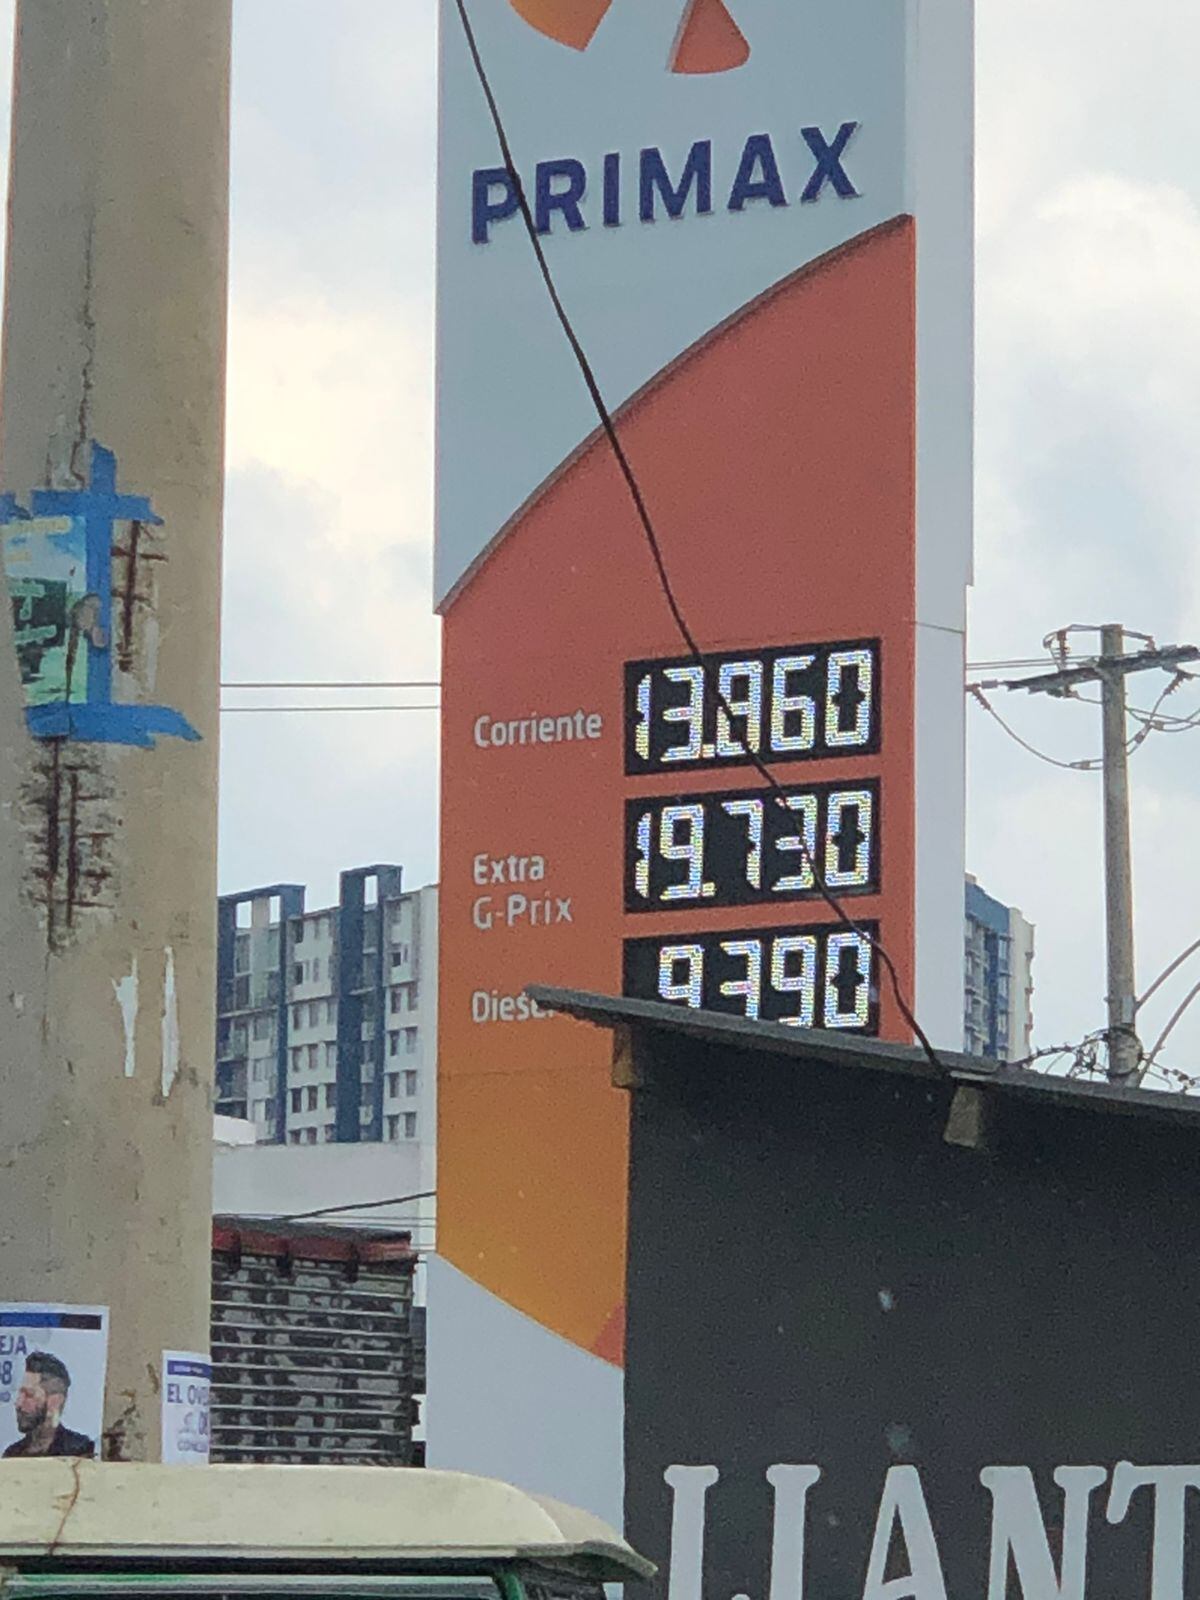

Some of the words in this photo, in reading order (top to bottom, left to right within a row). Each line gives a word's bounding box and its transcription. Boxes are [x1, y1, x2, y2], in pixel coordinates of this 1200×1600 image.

[472, 121, 860, 244] PRIMAX
[474, 709, 602, 748] Corriente
[634, 791, 873, 900] 19.730
[473, 853, 545, 885] Extra
[473, 891, 573, 929] G-Prix
[472, 989, 554, 1023] Diese
